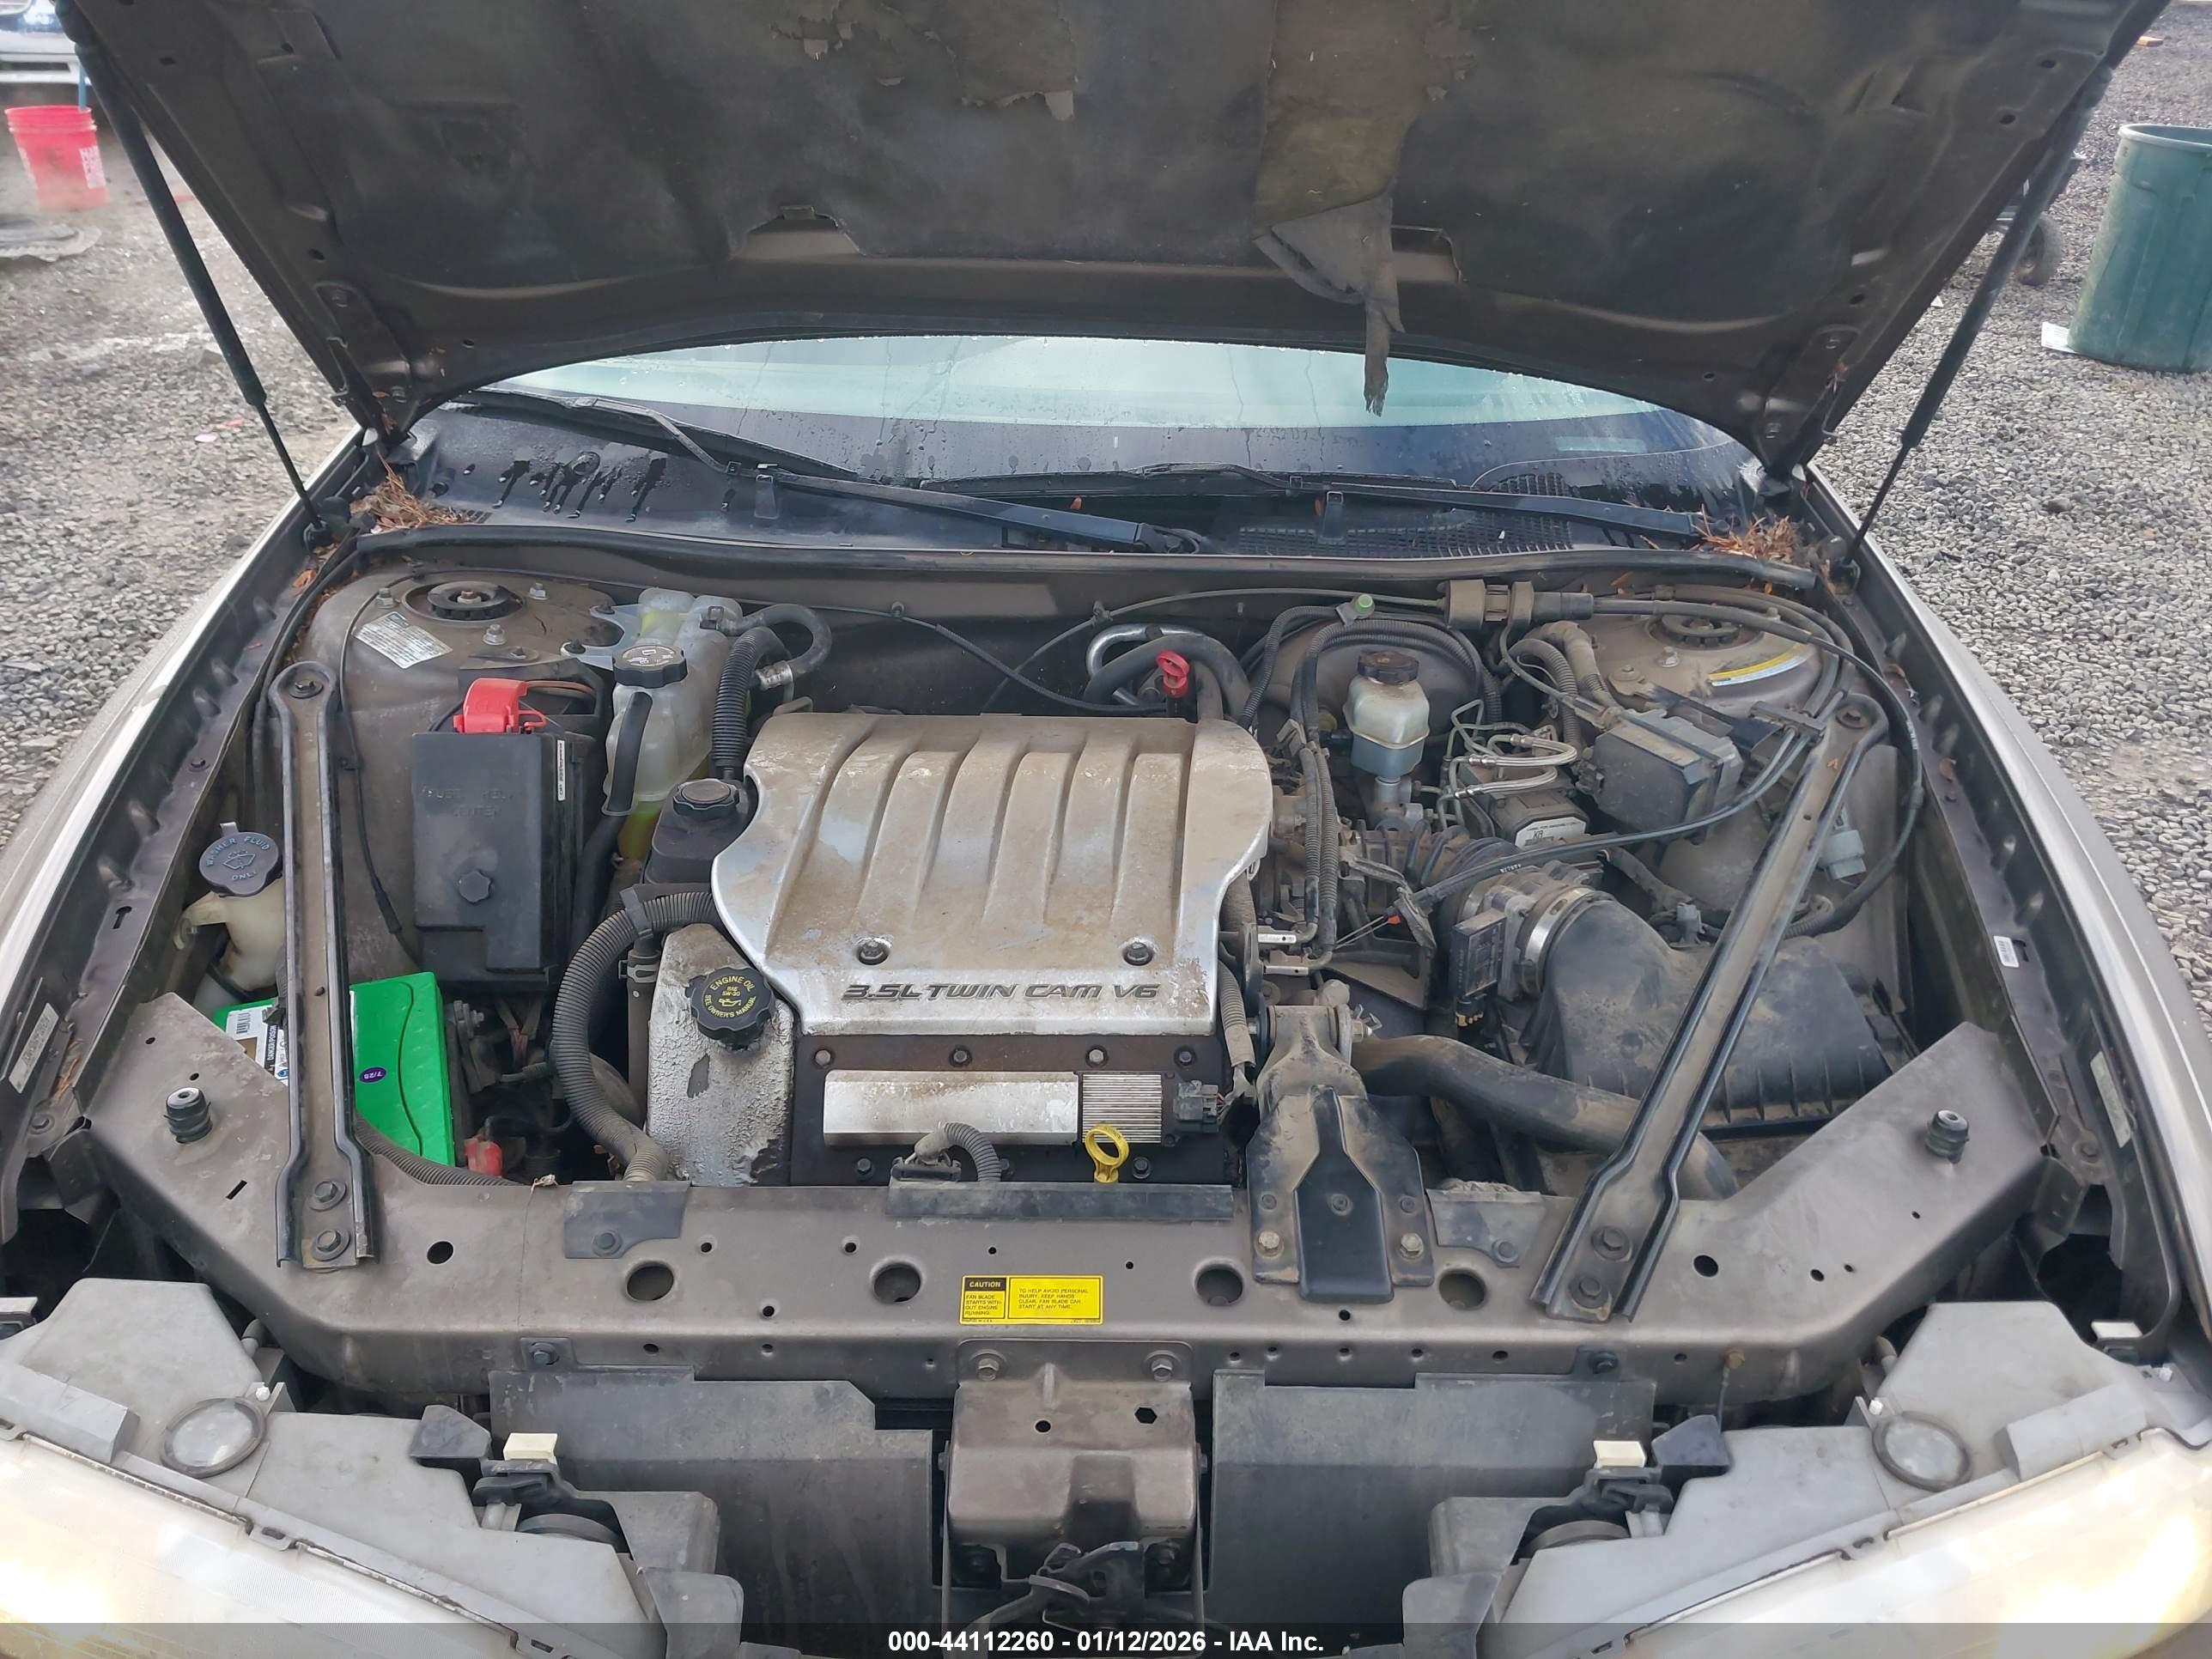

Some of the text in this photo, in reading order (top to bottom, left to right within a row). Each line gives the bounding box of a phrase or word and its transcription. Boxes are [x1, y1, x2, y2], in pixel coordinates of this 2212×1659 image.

[205, 836, 270, 866] WASHER FLUID
[232, 872, 257, 881] ONLY
[710, 975, 756, 992] ENGINE OIL
[841, 983, 1161, 1001] 3.5L TWIN CAM V6
[704, 994, 757, 1018] SEE OWNER'S MANUAL
